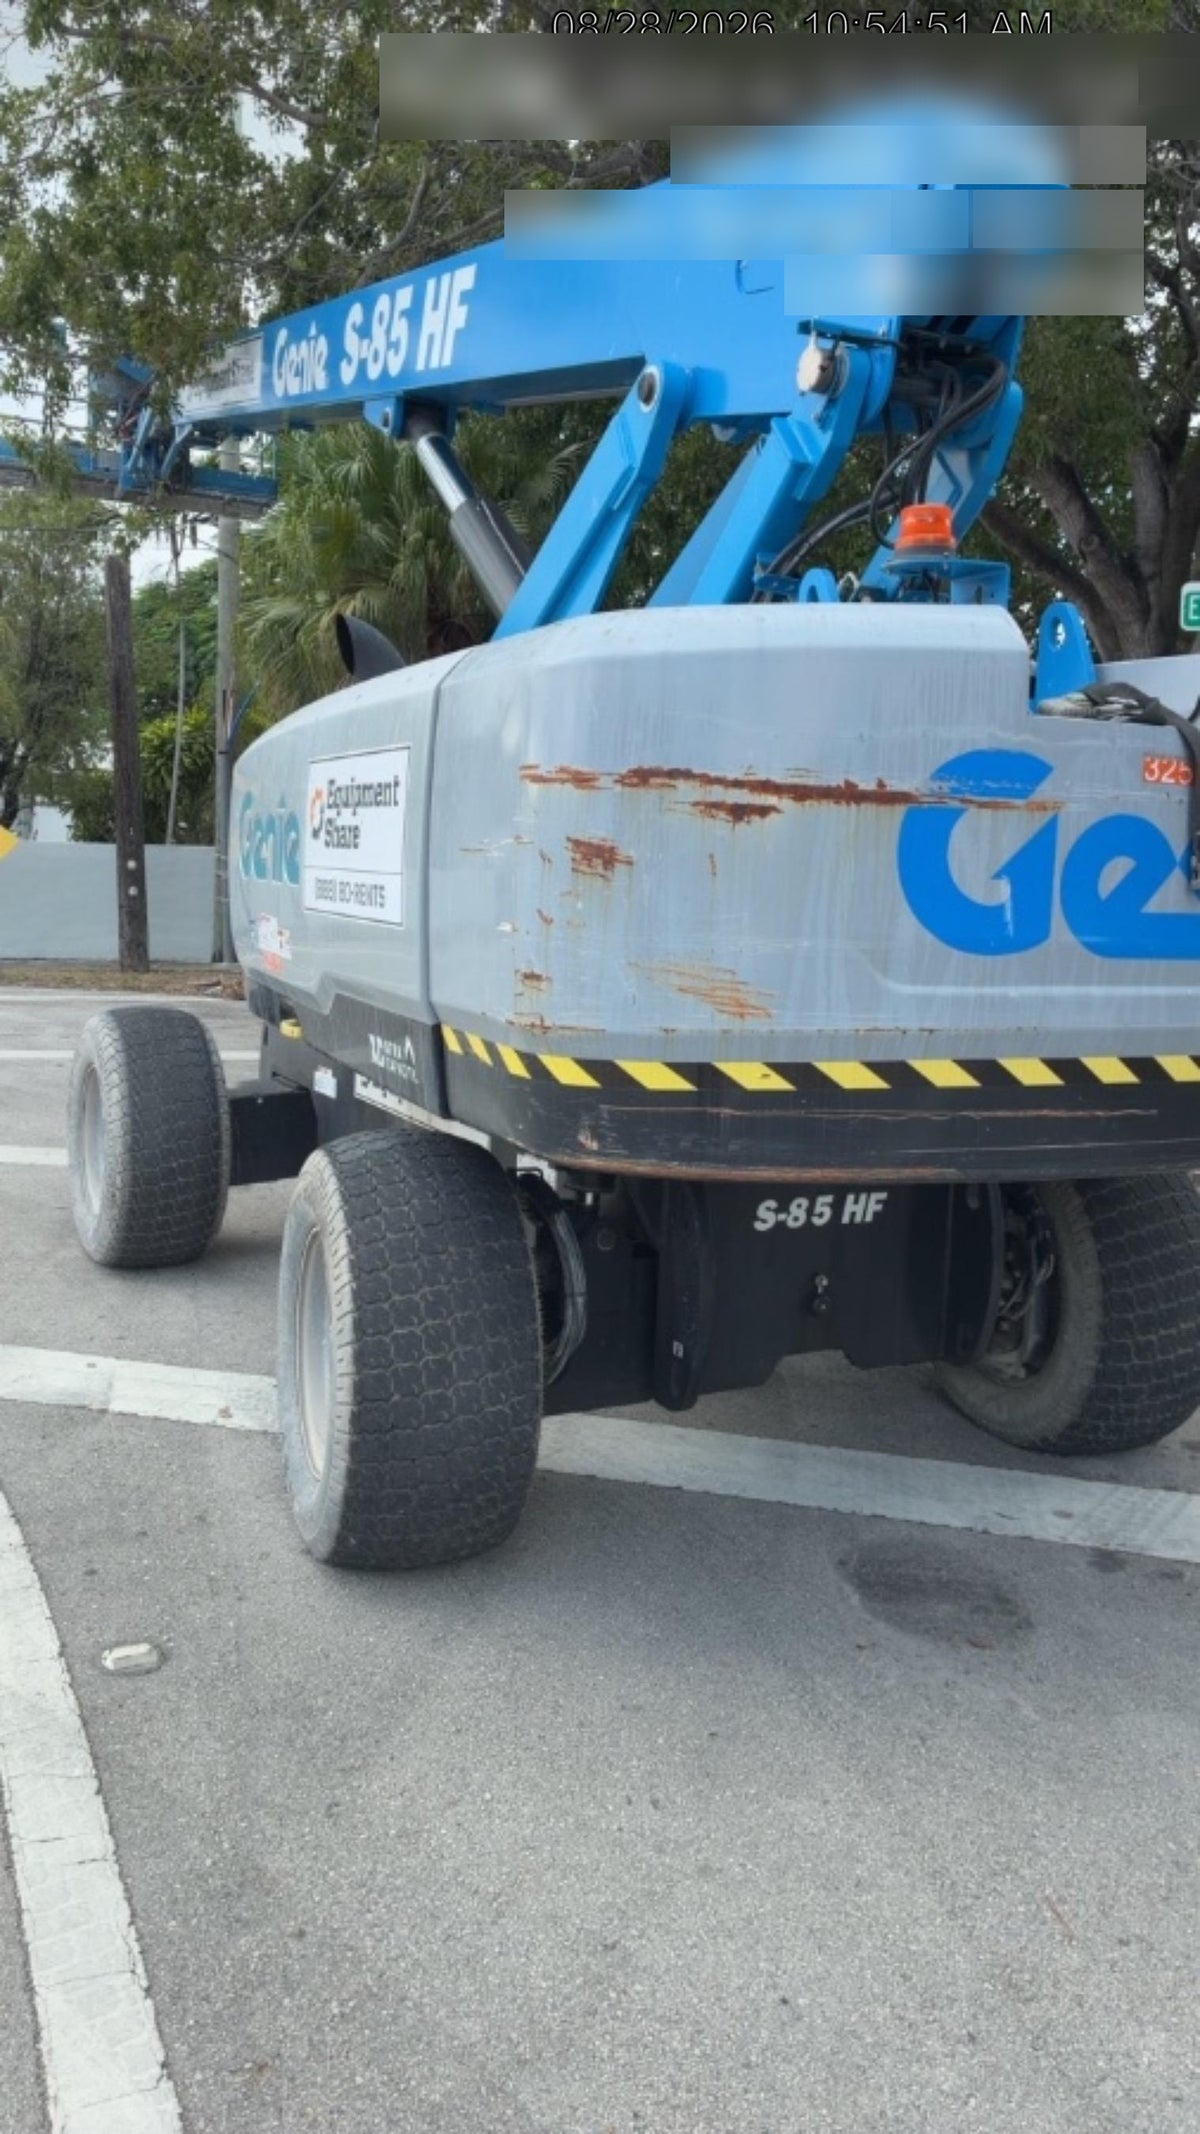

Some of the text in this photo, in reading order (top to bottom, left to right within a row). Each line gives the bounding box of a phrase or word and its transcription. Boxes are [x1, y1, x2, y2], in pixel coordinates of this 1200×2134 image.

[271, 263, 478, 398] Genie S-85 HF
[327, 775, 399, 817] Equipment
[239, 788, 300, 887] Genie
[324, 817, 361, 850] Share
[896, 749, 1200, 959] Ge
[753, 1192, 888, 1232] S-85 HF
